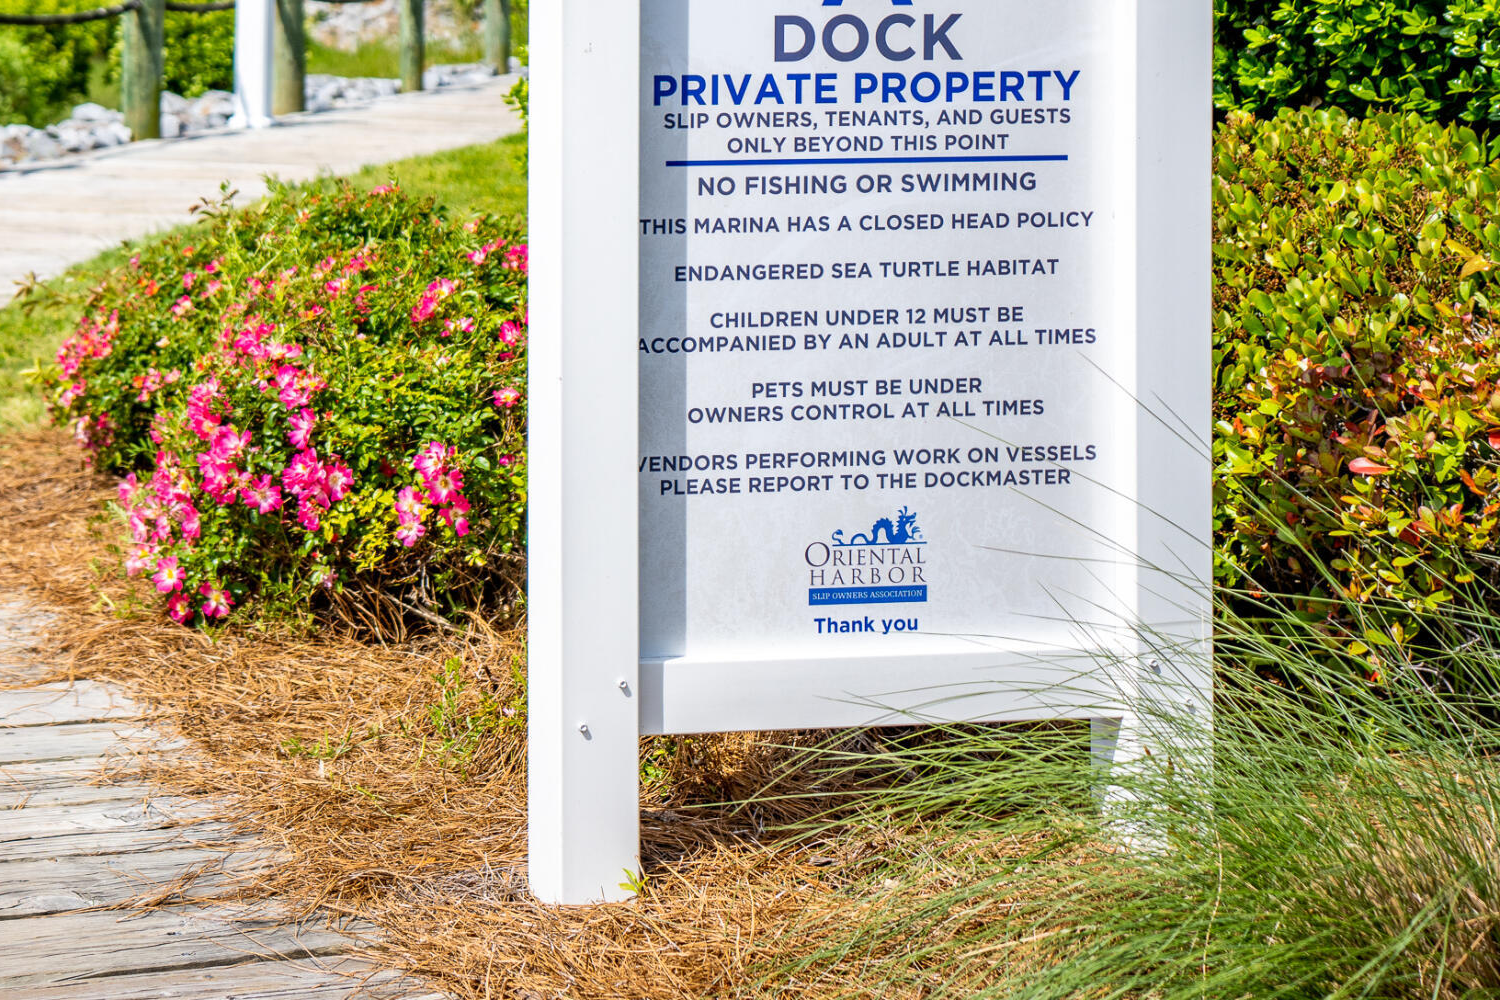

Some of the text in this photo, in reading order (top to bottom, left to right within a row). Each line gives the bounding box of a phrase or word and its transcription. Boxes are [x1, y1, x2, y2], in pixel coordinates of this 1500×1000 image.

[774, 13, 964, 63] DOCK
[652, 69, 1081, 108] PRIVATE PROPERTY
[662, 107, 1071, 132] SLIP OWNERS, TENANTS, AND GUESTS
[727, 133, 1010, 154] ONLY BEYOND THIS POINT
[698, 171, 1037, 196] NO FISHING OR SWIMMING
[638, 211, 1094, 236] THIS MARINA HAS A CLOSED HEAD POLICY
[674, 258, 1060, 283] ENDANGERED SEA TURTLE HABITAT
[710, 306, 1024, 329] CHILDREN UNDER 12 MUST BE
[638, 328, 1097, 354] ACCOMPANIED BY AN ADULT AT ALL TIMES
[752, 377, 982, 399] PETS MUST BE UNDER
[687, 399, 1045, 424] OWNERS CONTROL AT ALL TIMES
[745, 449, 886, 470] PERFORMING
[893, 447, 961, 466] WORK
[967, 446, 999, 464] ON
[1005, 444, 1097, 463] VESSELS
[660, 467, 1071, 496] PLEASE REPORT TO THE DOCKMASTER
[804, 541, 926, 567] ORIENTAL
[809, 566, 927, 586] HARBOR
[811, 588, 924, 602] SLIP OWNERS ASSOCIATION
[813, 616, 918, 635] Thank you
